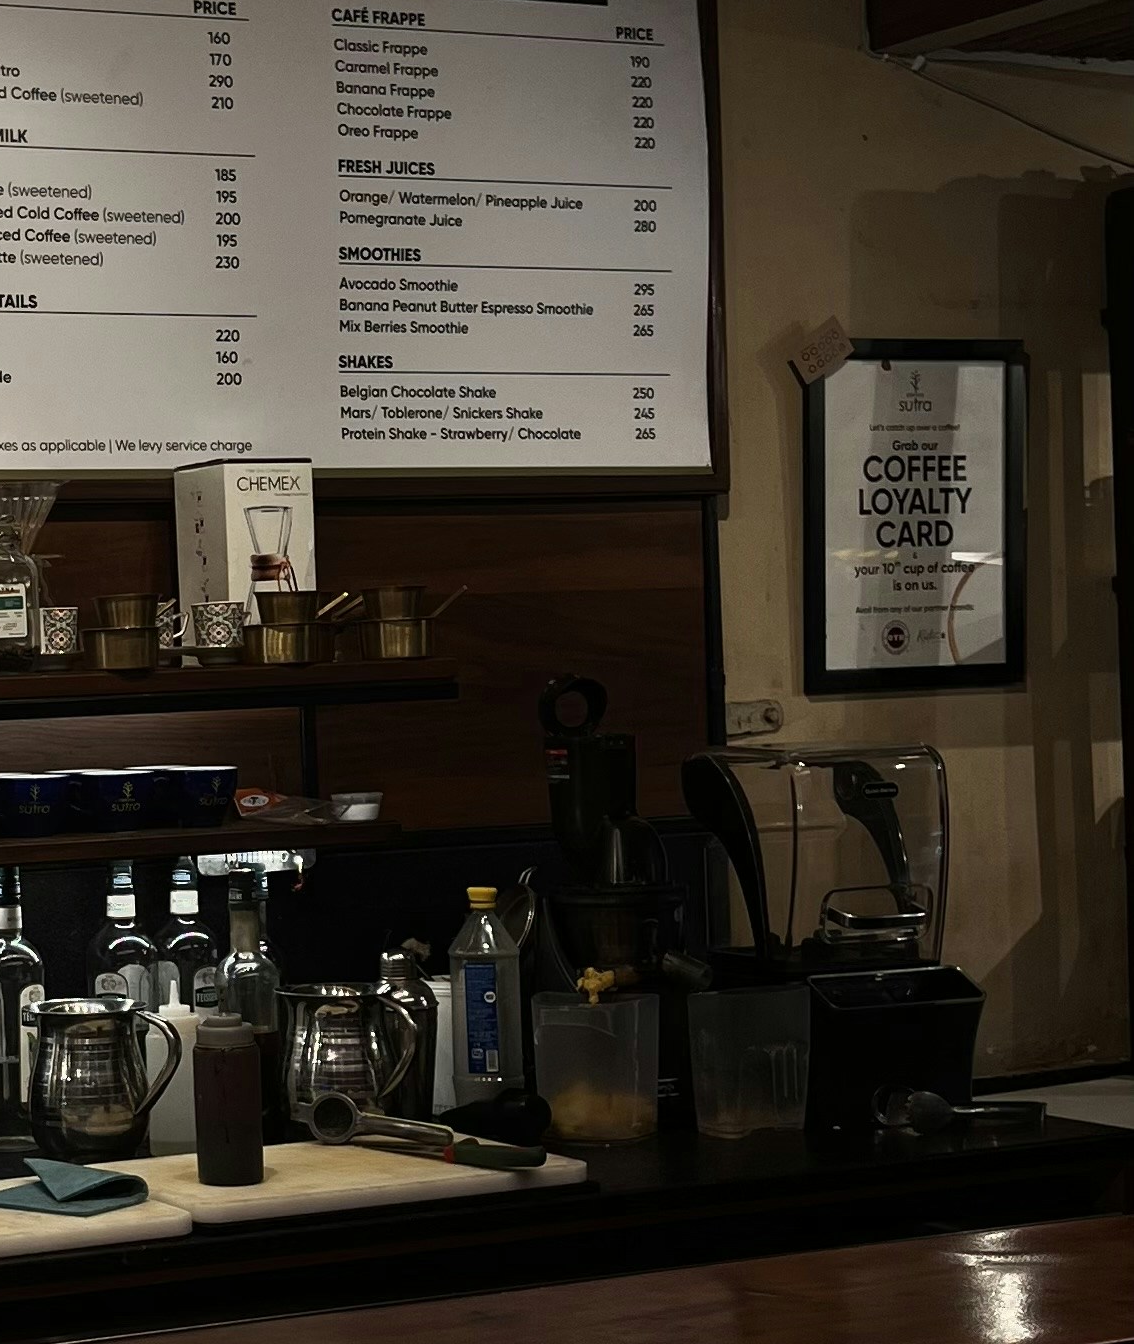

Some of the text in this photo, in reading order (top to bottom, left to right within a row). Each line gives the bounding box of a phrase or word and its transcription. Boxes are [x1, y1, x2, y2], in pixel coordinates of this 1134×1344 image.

[193, 0, 236, 15] PRICE
[332, 7, 654, 41] CAFÉ FRAPPE PRICE
[207, 32, 230, 45] 160
[334, 38, 650, 68] Classic Frappe 190
[338, 159, 435, 176] FRESH JUICES
[339, 189, 657, 212] Orange/ Watermelon/ Pineapple Juice 200
[17, 206, 50, 220] Cold
[54, 207, 99, 221] Coffee
[103, 207, 185, 225] (sweetened)
[216, 212, 241, 225] 200
[338, 246, 421, 262] SMOOTHIES
[339, 277, 654, 296] Avocado Smoothie 295
[216, 329, 240, 342] 220
[338, 355, 393, 369] SHAKES
[340, 385, 654, 401] Belgian Chocolate Shake 250
[899, 398, 932, 412] sutra
[342, 427, 385, 440] Protein
[389, 427, 427, 440] Shake
[440, 427, 514, 442] Strawberry/
[518, 427, 581, 440] Chocolate
[635, 428, 656, 440] 265
[21, 442, 36, 451] as
[39, 439, 106, 454] applicable
[115, 440, 136, 451] We
[139, 439, 162, 454] levy
[166, 442, 207, 451] service
[210, 440, 252, 454] charge
[892, 440, 938, 451] Grab our
[863, 455, 966, 482] COFFEE
[237, 476, 300, 491] CHEMEX
[859, 487, 972, 515] LOYALTY
[876, 520, 953, 548] CARD
[854, 563, 880, 578] your
[903, 562, 925, 576] cup
[927, 562, 939, 575] of
[941, 562, 976, 574] coffee
[892, 579, 937, 591] is on us.
